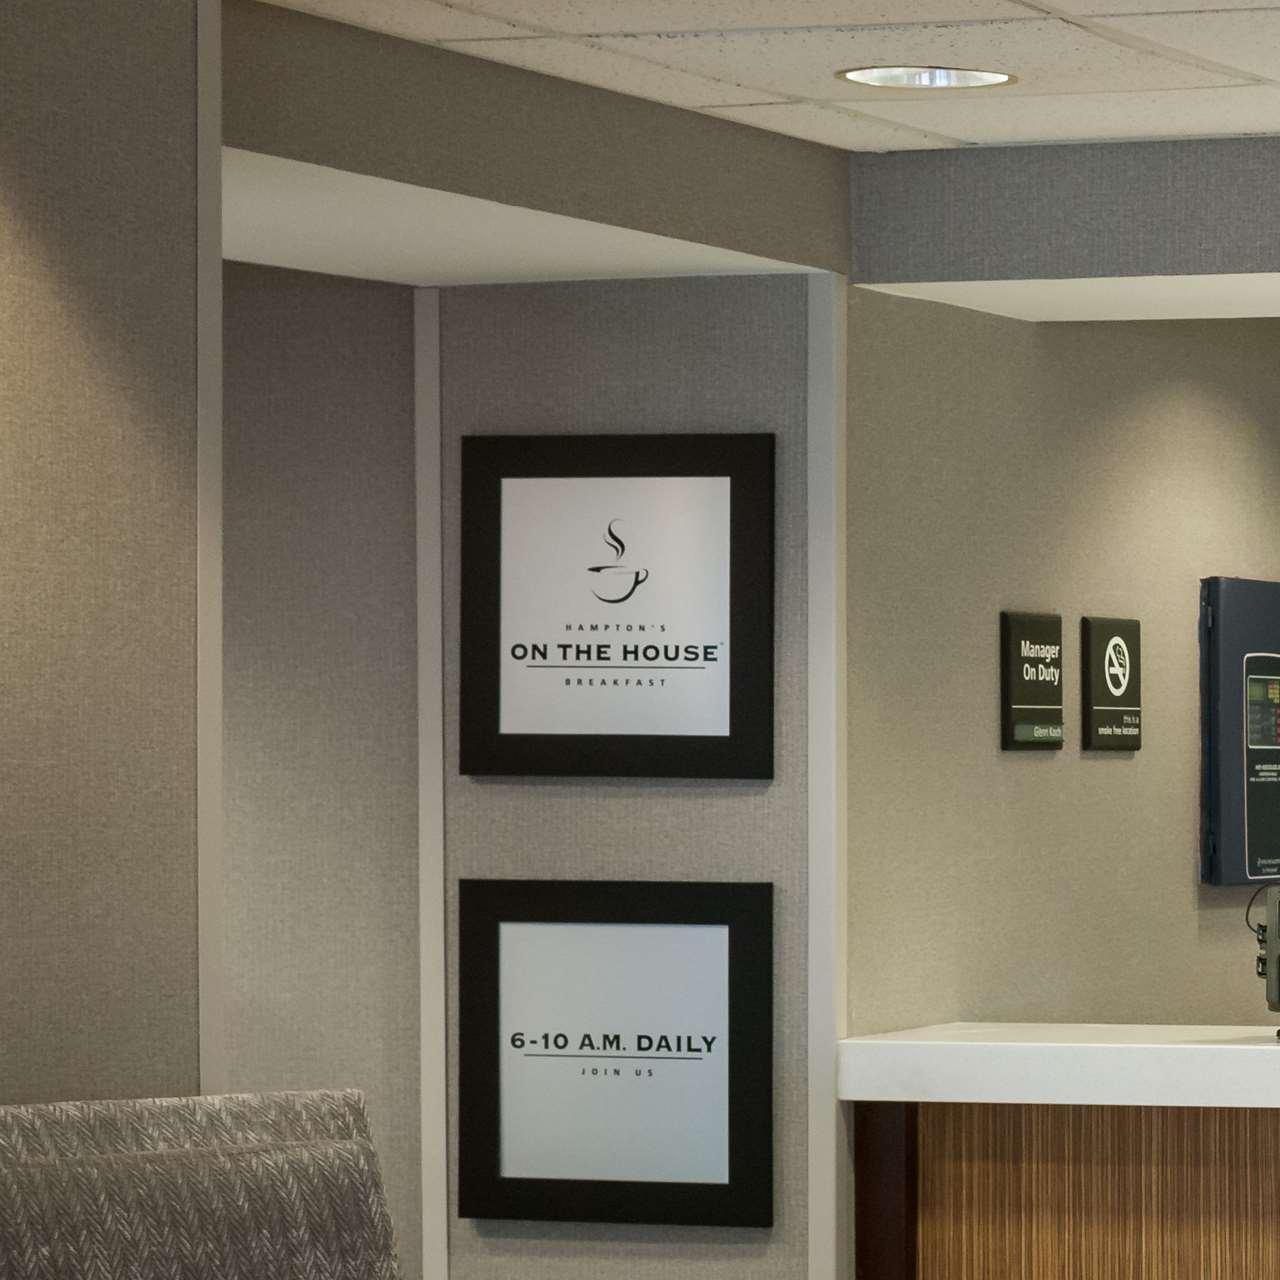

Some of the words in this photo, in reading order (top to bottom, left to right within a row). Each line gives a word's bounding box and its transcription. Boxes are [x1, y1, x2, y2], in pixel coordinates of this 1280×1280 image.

[565, 623, 666, 632] HAMPTON'S
[510, 643, 548, 661] ON
[556, 643, 611, 661] THE
[622, 644, 718, 662] HOUSE
[1021, 640, 1060, 662] Manager
[564, 678, 666, 687] BREAKFAST
[1023, 663, 1037, 681] On
[1038, 663, 1060, 686] Duty
[510, 1032, 569, 1050] 6-10
[578, 1033, 627, 1051] A.M.
[636, 1034, 717, 1053] DAILY
[581, 1068, 621, 1076] JOIN
[635, 1068, 654, 1077] US
